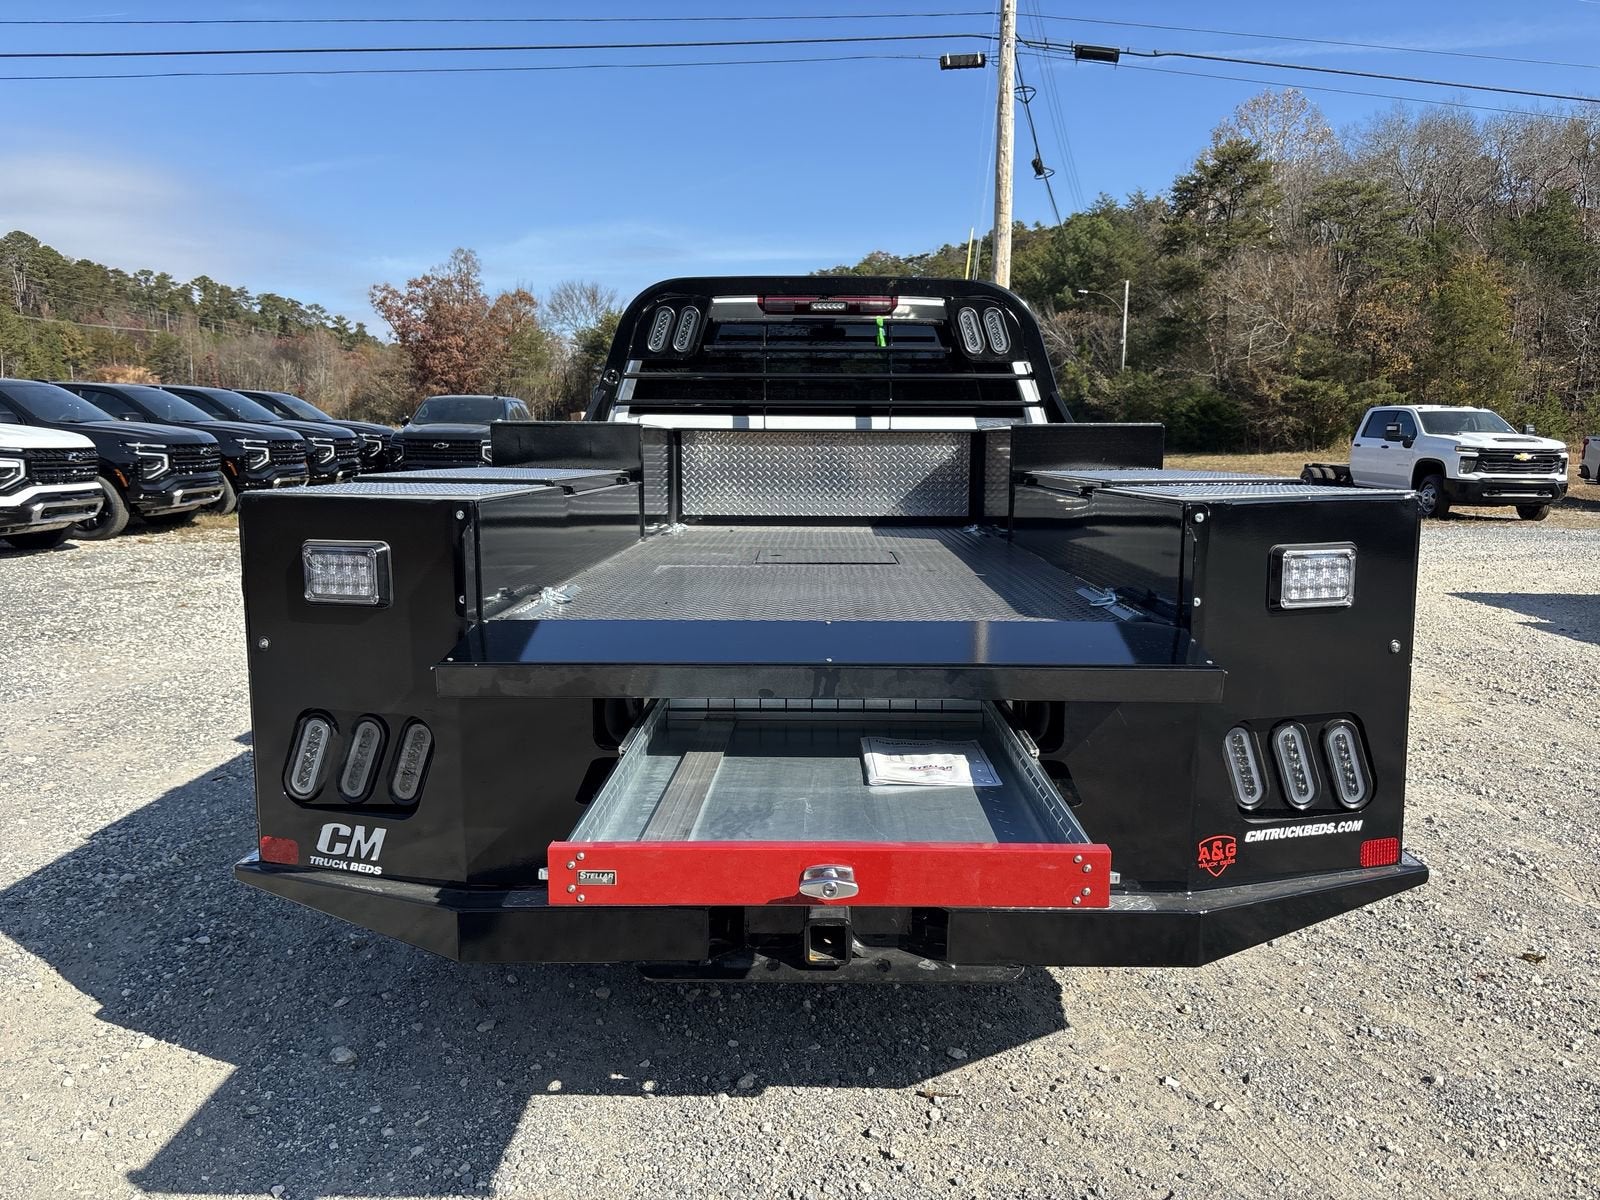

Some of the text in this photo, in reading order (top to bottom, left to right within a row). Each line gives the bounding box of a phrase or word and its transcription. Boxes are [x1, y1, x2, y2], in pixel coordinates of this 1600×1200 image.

[1244, 820, 1364, 843] CMTRUCKBEDS.COM
[316, 823, 387, 861] CM
[1198, 841, 1237, 861] A&G
[310, 856, 383, 876] TRUCK BEDS
[579, 871, 614, 880] STELLAR
